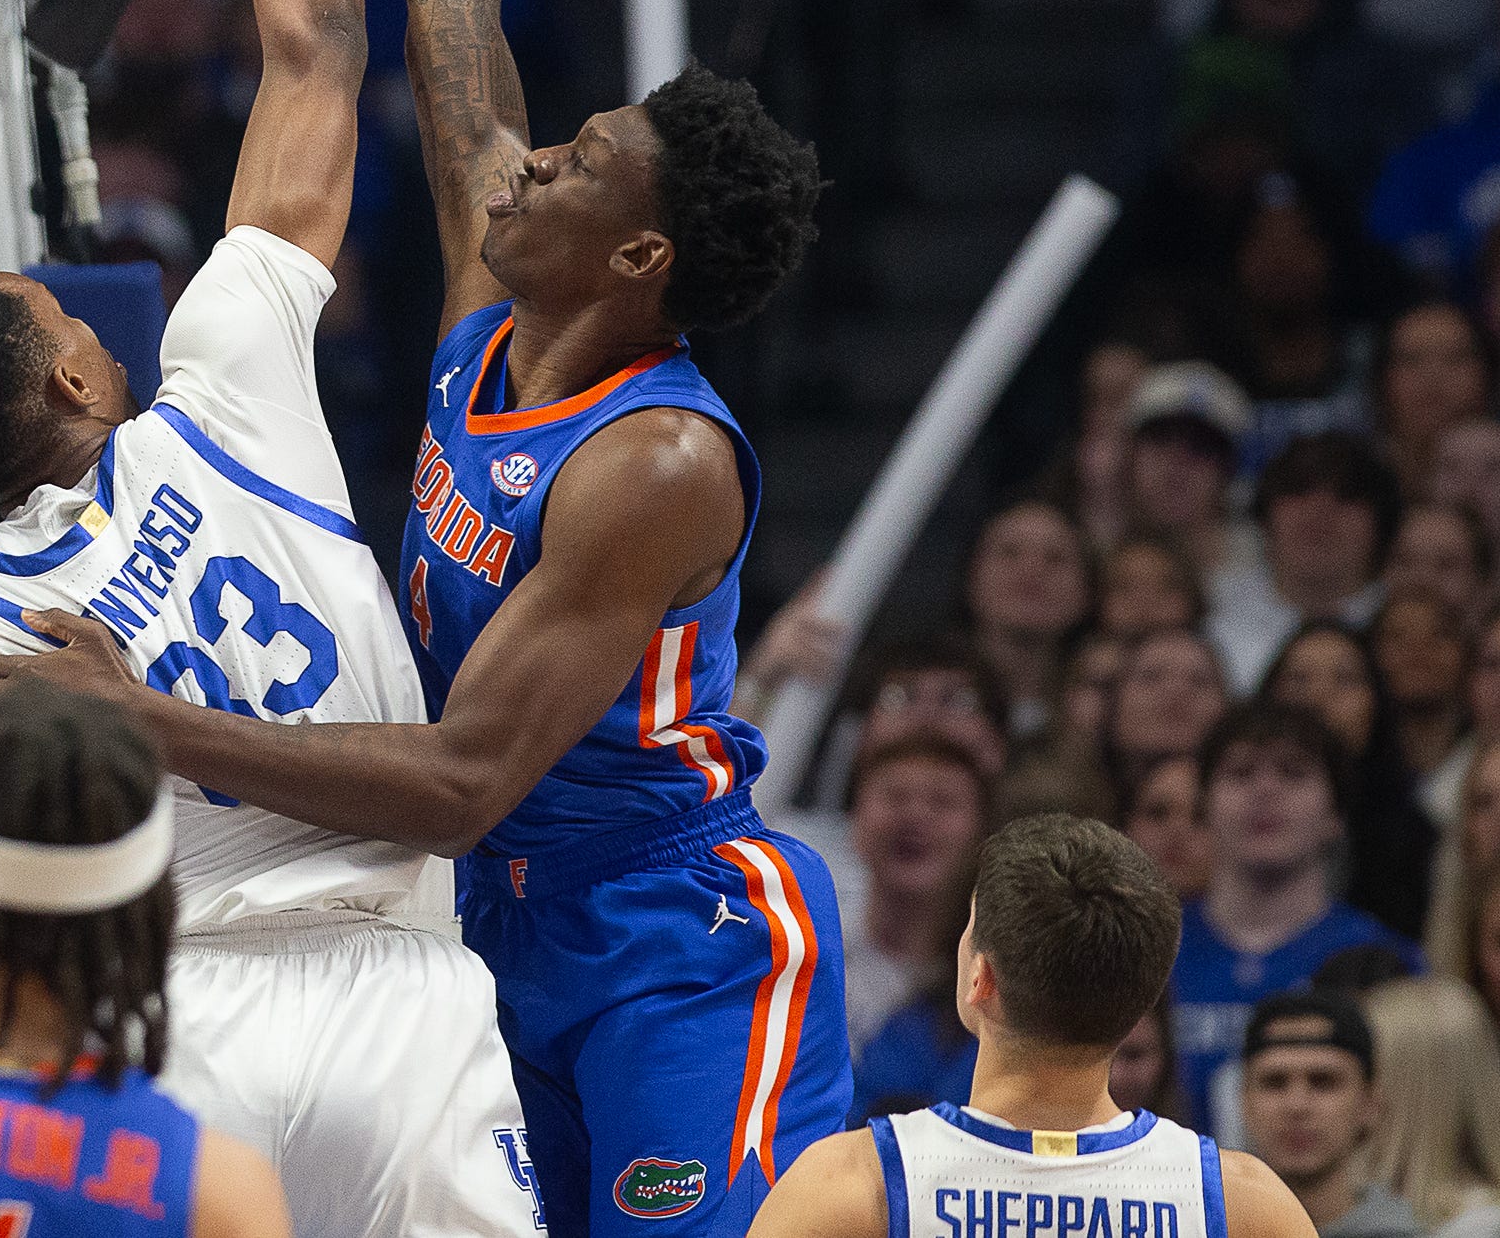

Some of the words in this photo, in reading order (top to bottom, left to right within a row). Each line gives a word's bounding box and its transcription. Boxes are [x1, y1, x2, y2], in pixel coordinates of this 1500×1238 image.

[503, 455, 537, 485] SEC
[409, 555, 434, 650] 4
[508, 857, 529, 898] F
